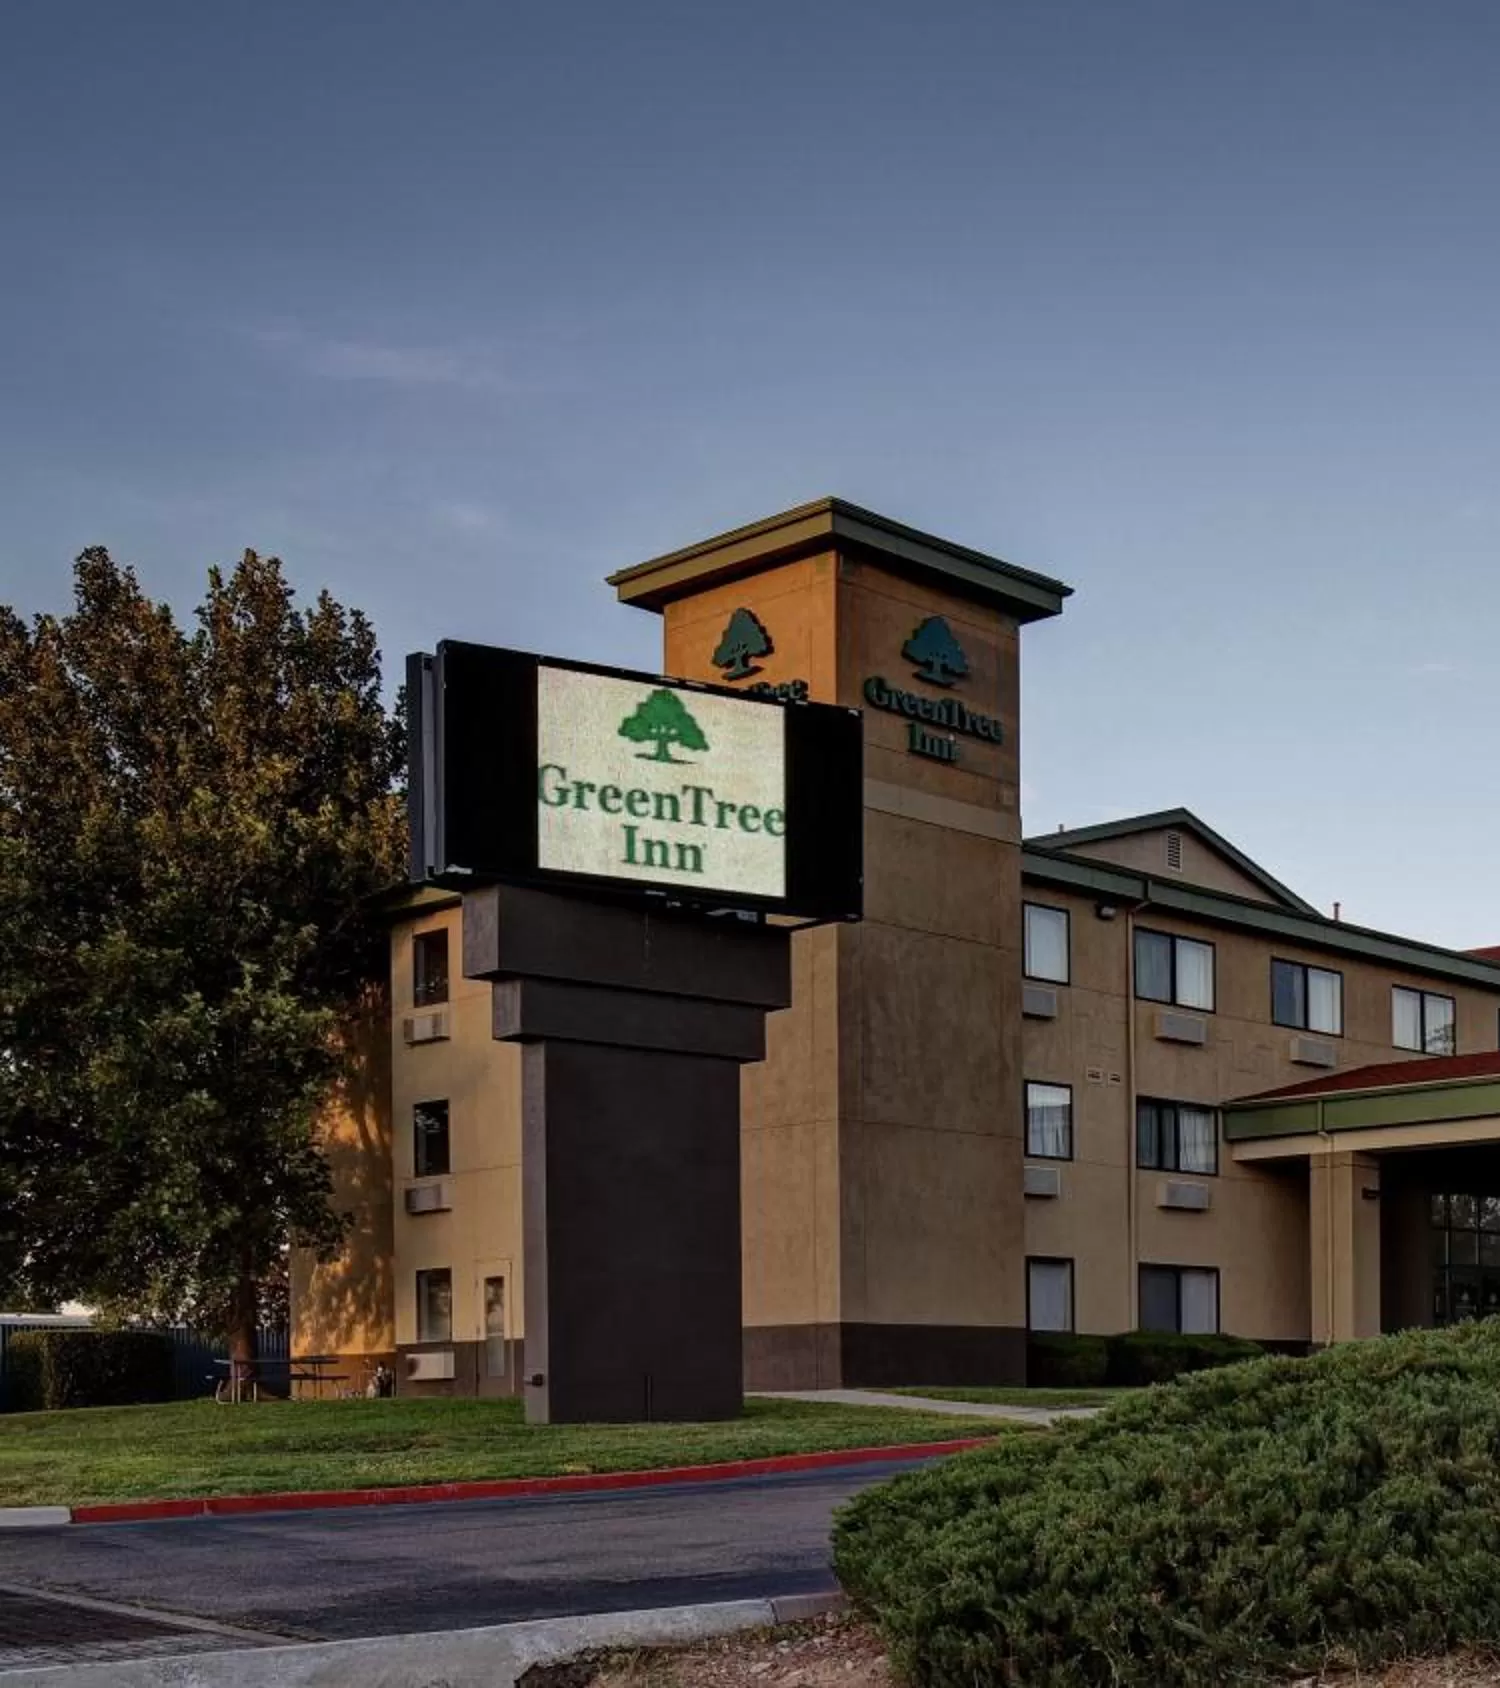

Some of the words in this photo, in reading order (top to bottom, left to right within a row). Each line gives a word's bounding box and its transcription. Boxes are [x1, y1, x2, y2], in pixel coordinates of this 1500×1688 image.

[863, 676, 1004, 744] GreenTree
[906, 721, 960, 763] Inn
[538, 763, 785, 837] GreenTree
[620, 824, 704, 874] Inn
